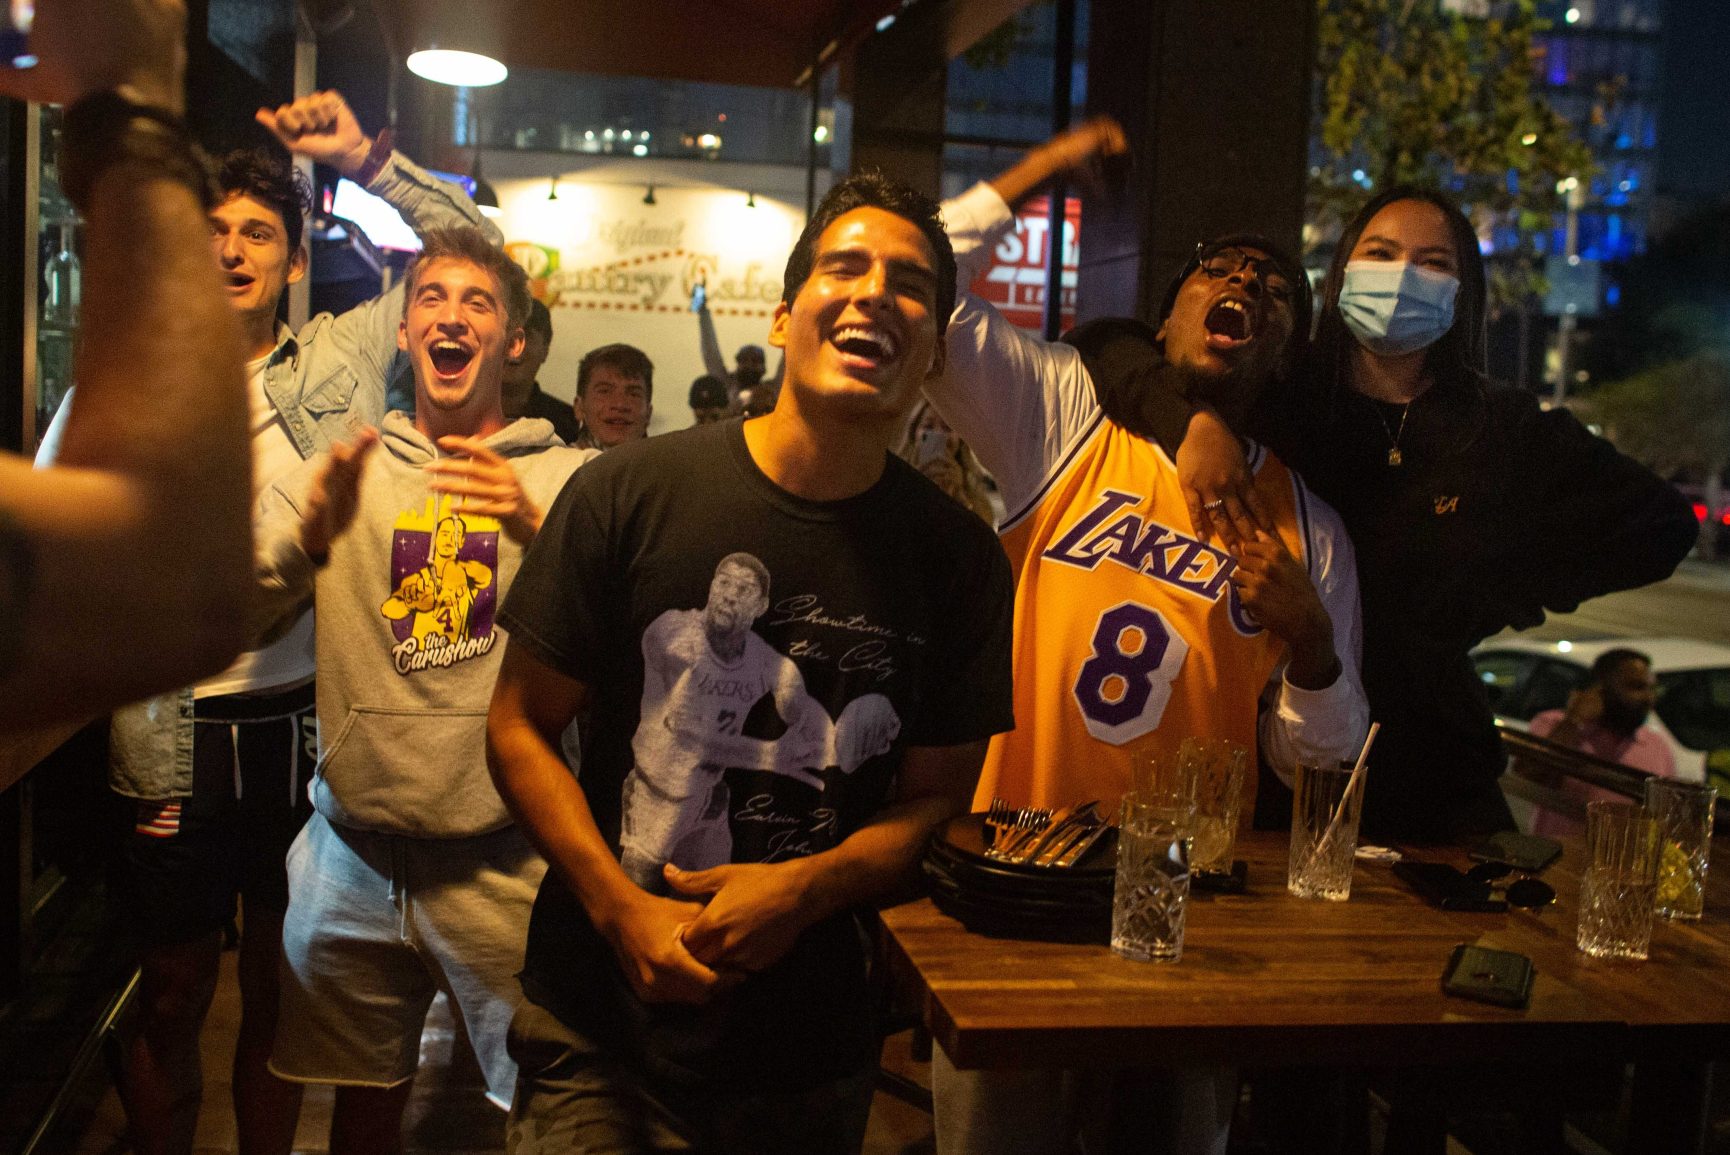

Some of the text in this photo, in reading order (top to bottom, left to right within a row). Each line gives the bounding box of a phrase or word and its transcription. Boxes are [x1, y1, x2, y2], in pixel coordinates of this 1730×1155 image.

[437, 608, 454, 632] 4
[425, 632, 447, 648] the
[789, 641, 829, 660] the
[1073, 600, 1189, 745] 8
